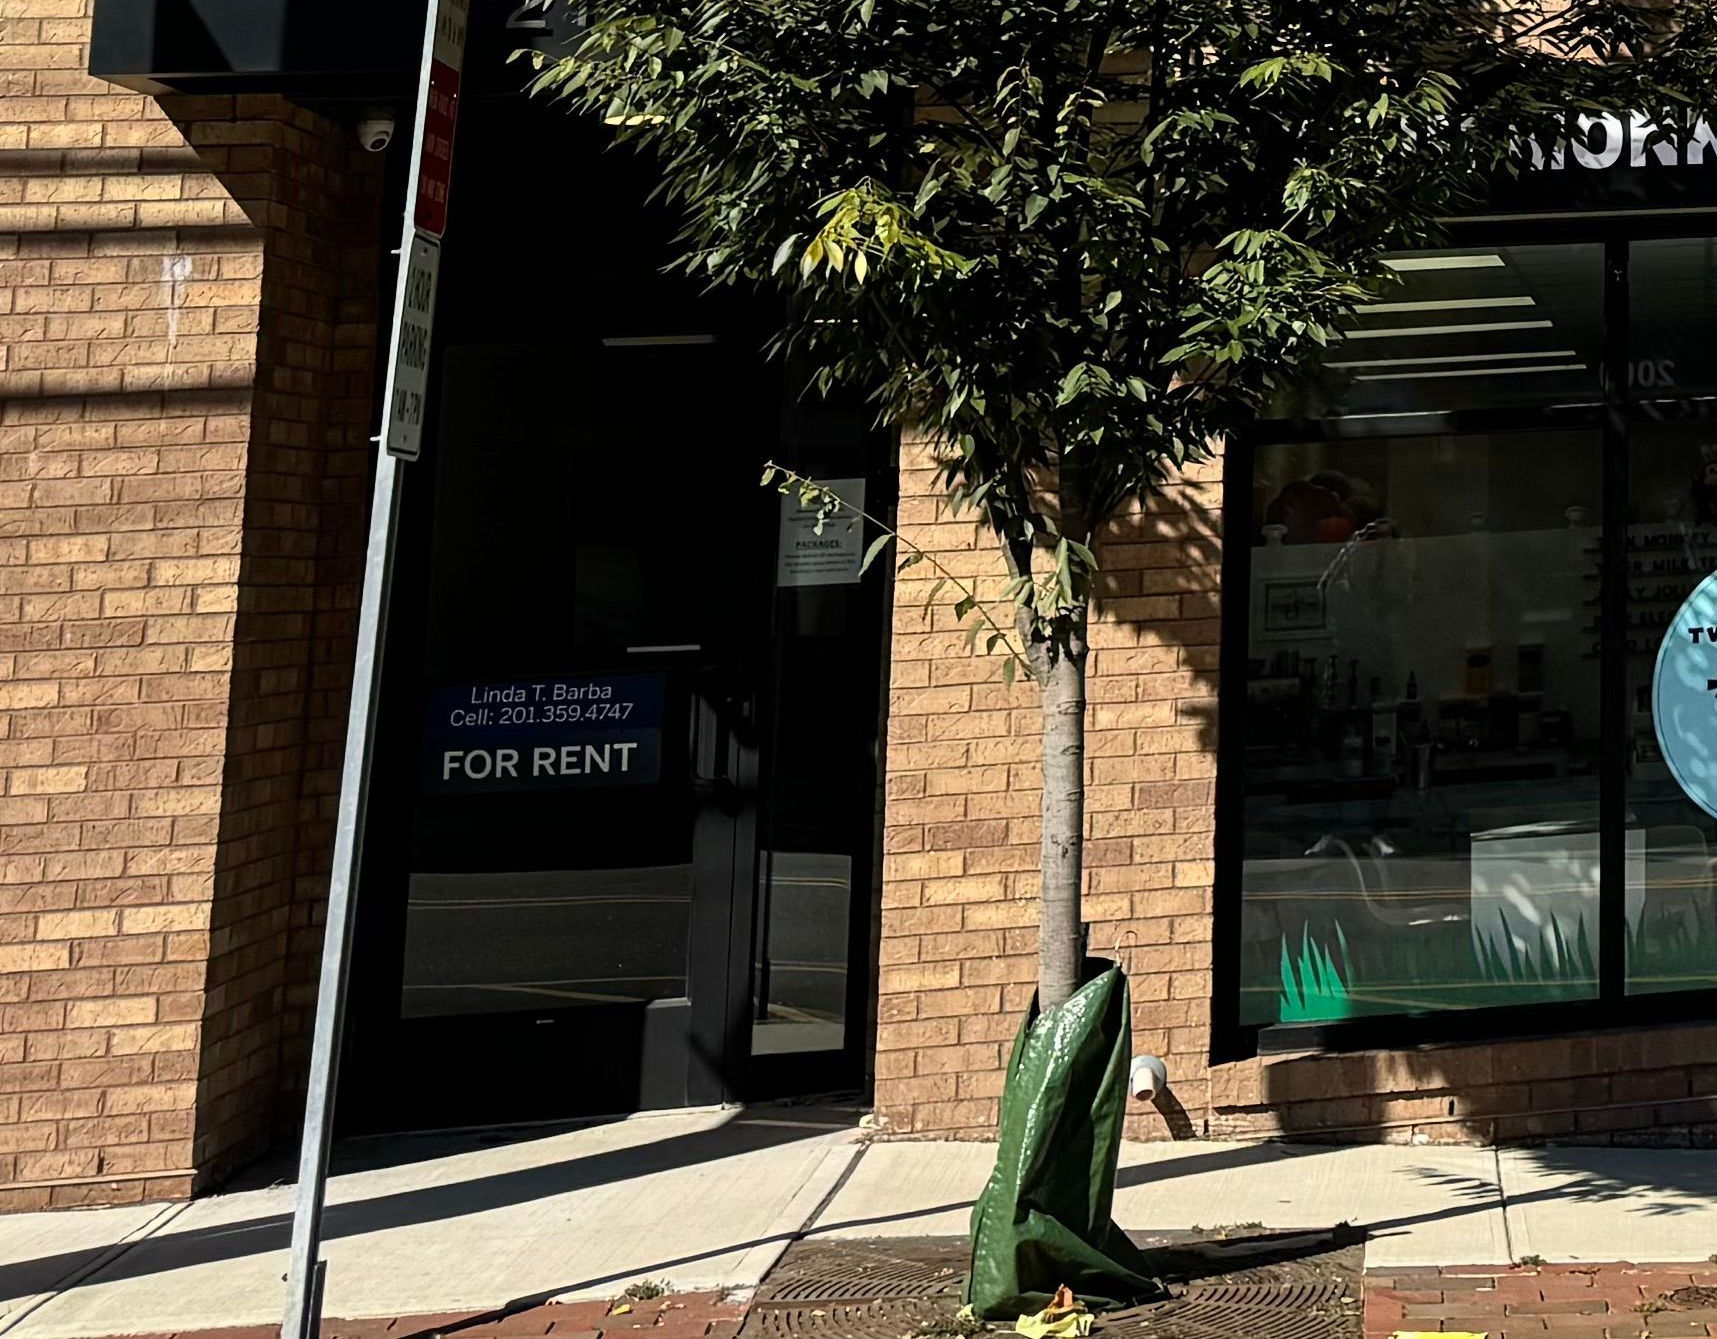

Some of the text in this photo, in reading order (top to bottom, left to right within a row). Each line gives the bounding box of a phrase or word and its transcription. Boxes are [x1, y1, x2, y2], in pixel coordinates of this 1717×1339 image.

[471, 683, 612, 704] Linda T. Barba
[450, 703, 634, 727] Cell: 201.359.4747
[443, 742, 638, 781] FOR RENT
